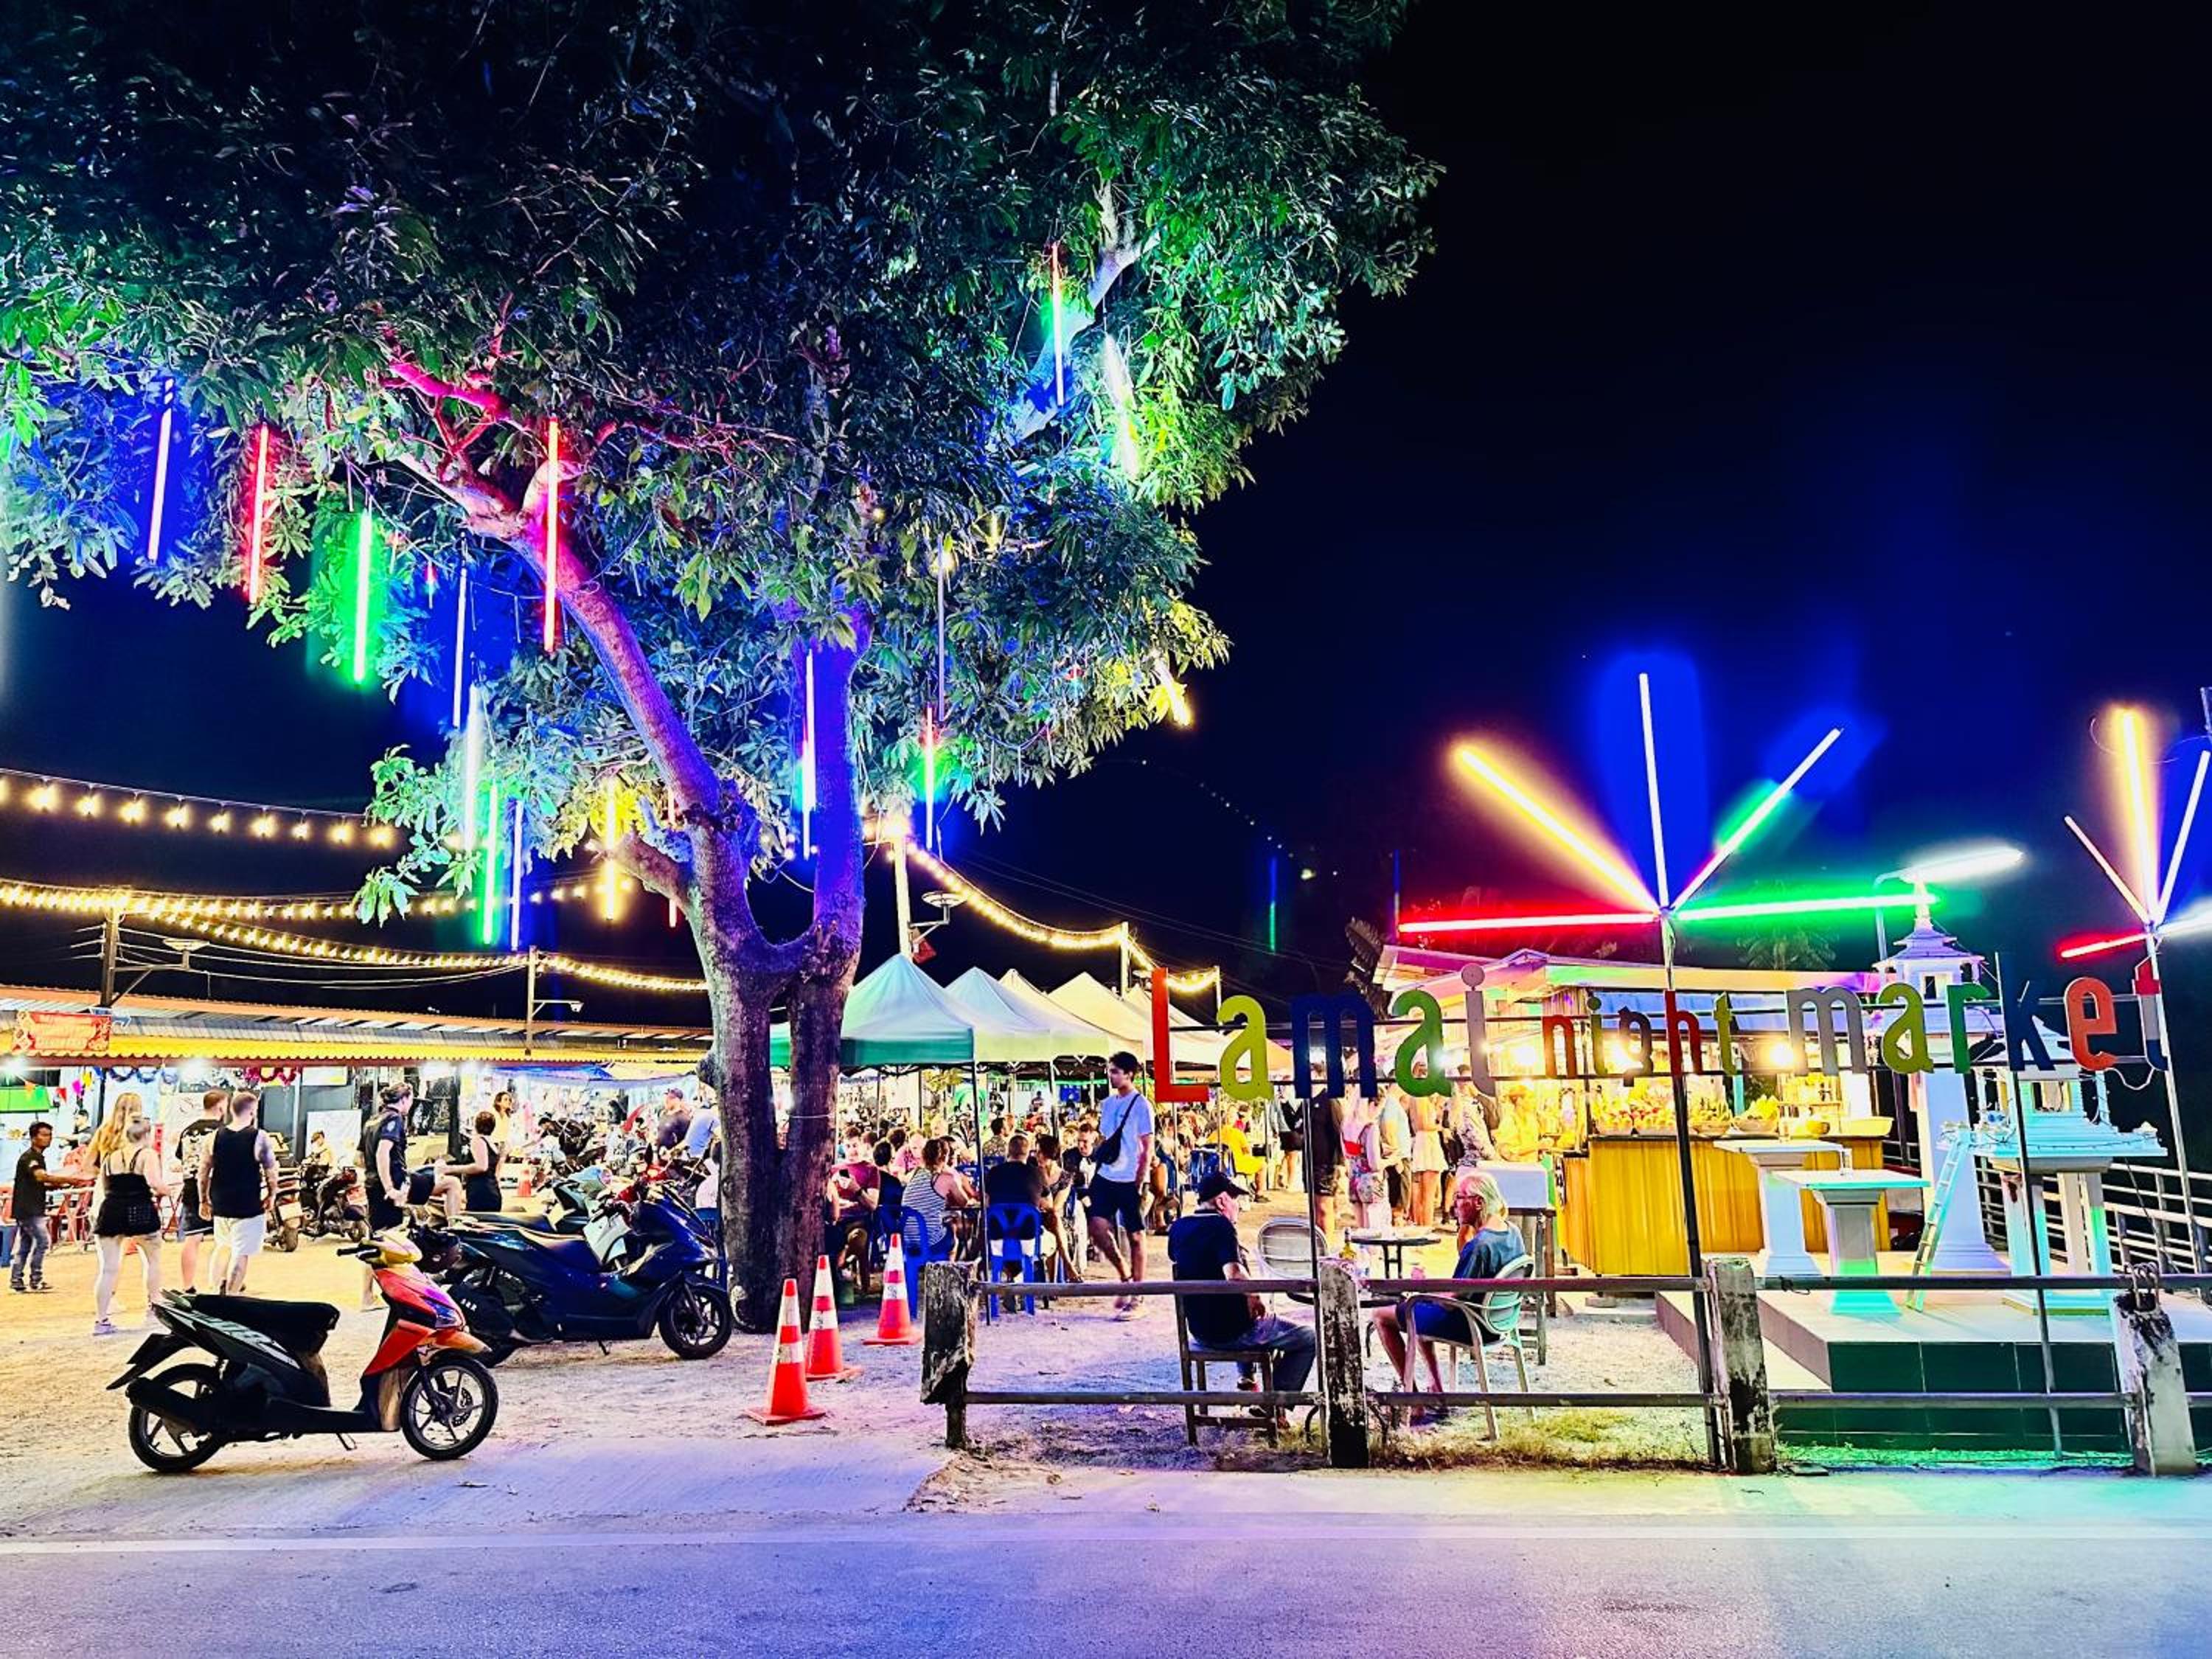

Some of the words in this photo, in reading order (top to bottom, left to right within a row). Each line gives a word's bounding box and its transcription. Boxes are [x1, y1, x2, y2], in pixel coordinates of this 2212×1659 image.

[1151, 964, 1496, 1103] Lamai
[1542, 990, 1738, 1088] night
[1786, 952, 2169, 1074] market
